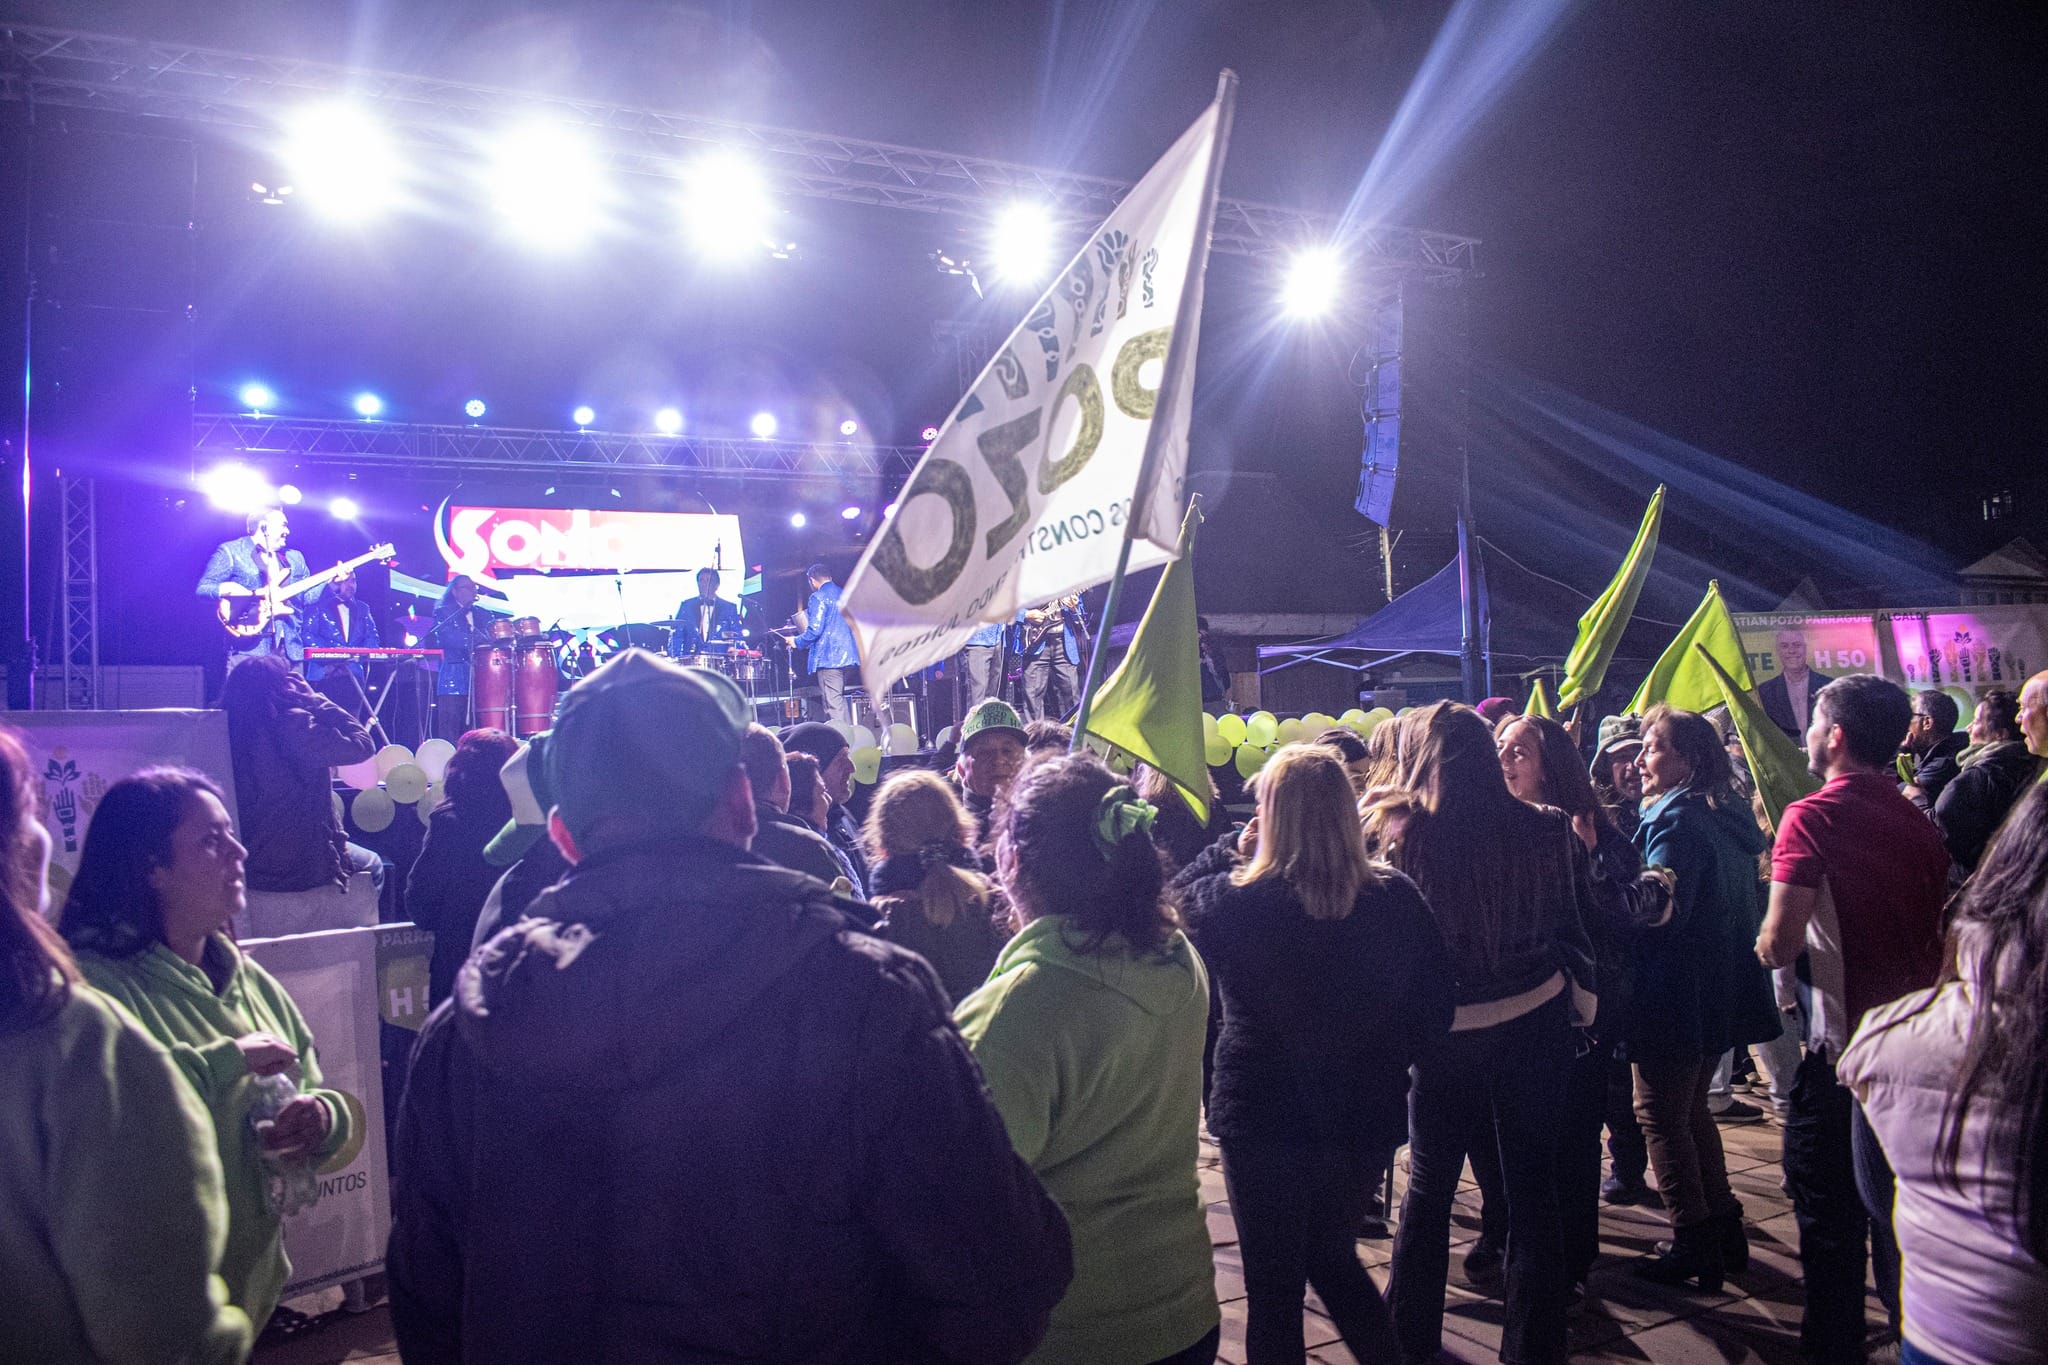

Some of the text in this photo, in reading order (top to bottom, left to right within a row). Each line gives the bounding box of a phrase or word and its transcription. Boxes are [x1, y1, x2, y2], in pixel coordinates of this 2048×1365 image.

[1733, 615, 1768, 627] STIAN
[1769, 614, 1802, 626] POZO
[1880, 611, 1930, 623] ALCALDE
[1748, 652, 1774, 671] TE
[1814, 649, 1866, 670] H 50
[390, 987, 413, 1017] H
